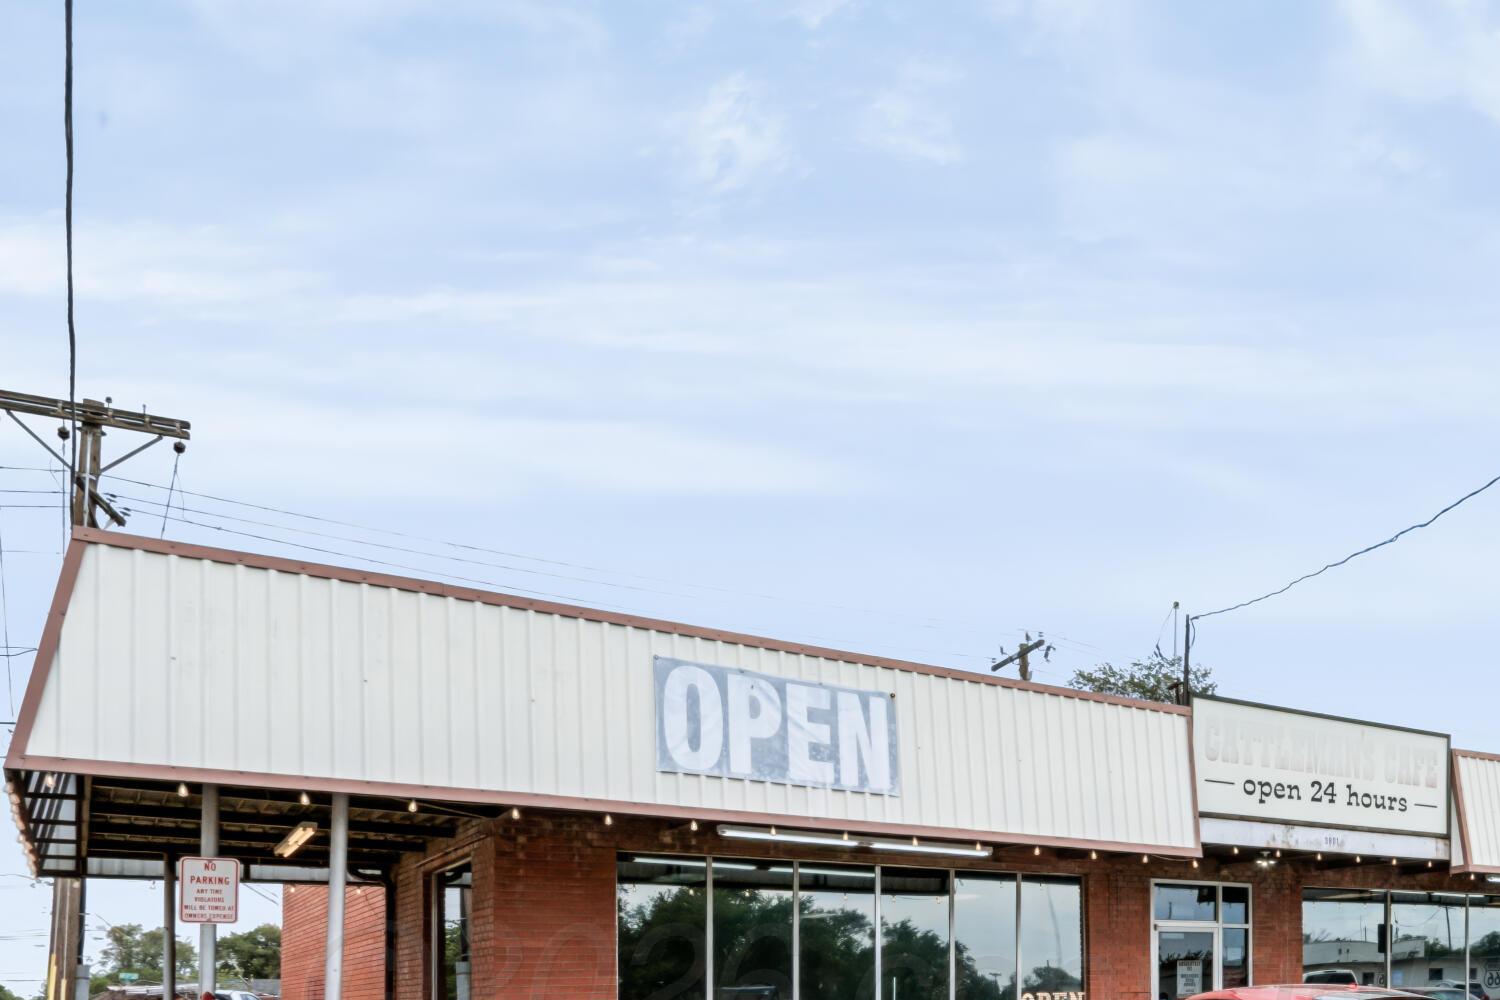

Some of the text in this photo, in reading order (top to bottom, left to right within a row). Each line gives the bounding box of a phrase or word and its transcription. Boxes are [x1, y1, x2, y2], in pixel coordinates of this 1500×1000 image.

[663, 665, 891, 791] OPEN
[1243, 778, 1408, 812] open 24 hours
[204, 862, 216, 871] NO
[190, 875, 230, 885] PARKING
